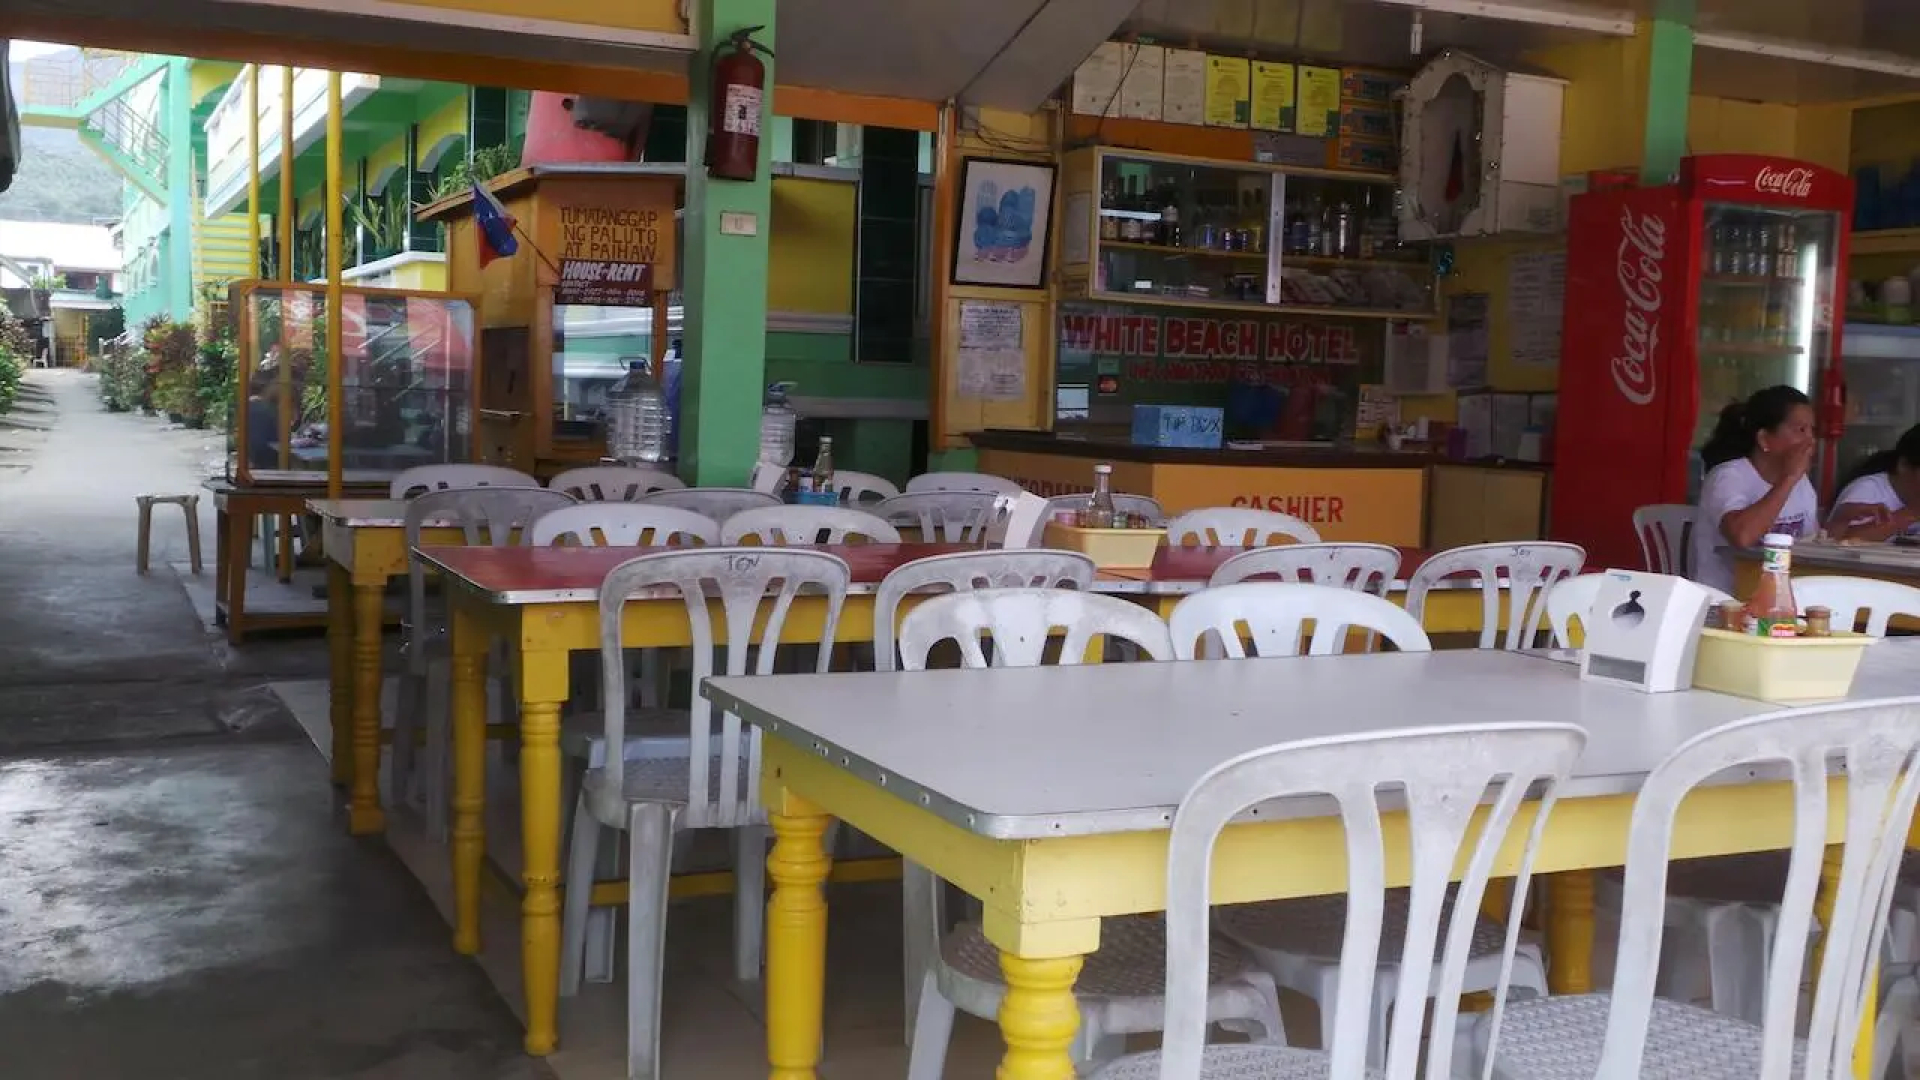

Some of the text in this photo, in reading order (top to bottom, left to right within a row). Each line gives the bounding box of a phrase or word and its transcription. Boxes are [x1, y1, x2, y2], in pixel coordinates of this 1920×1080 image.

[560, 206, 658, 228] TUMATANGGAP
[563, 224, 658, 245] NG PALUTO
[564, 241, 657, 263] AT PAIHAW
[1062, 313, 1159, 356] WHITE
[1163, 316, 1259, 360] BEACH
[1265, 321, 1360, 364] HOTEL
